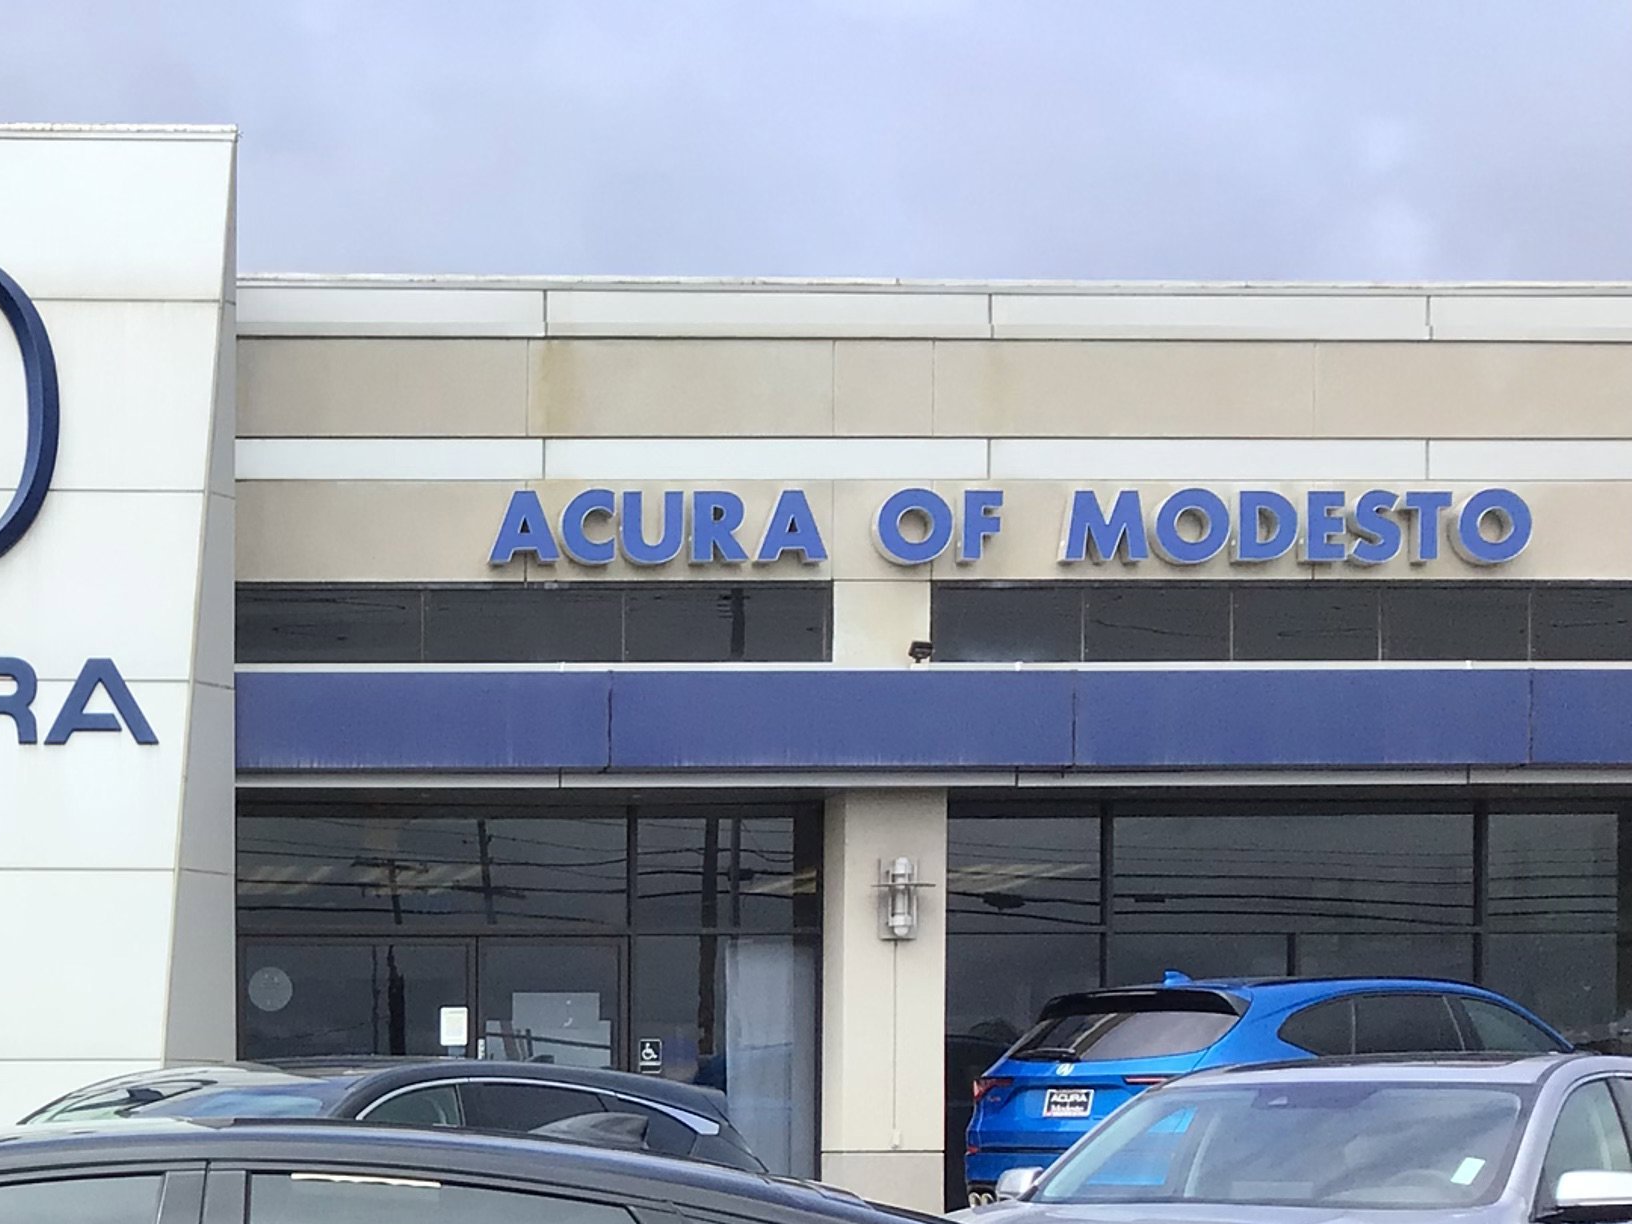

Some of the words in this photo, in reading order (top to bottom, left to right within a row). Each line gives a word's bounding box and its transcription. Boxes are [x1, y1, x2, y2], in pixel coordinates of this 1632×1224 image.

[488, 488, 829, 567] ACURA
[871, 488, 1004, 567] OF
[1057, 488, 1534, 566] MODESTO
[1049, 1093, 1087, 1102] ACURA
